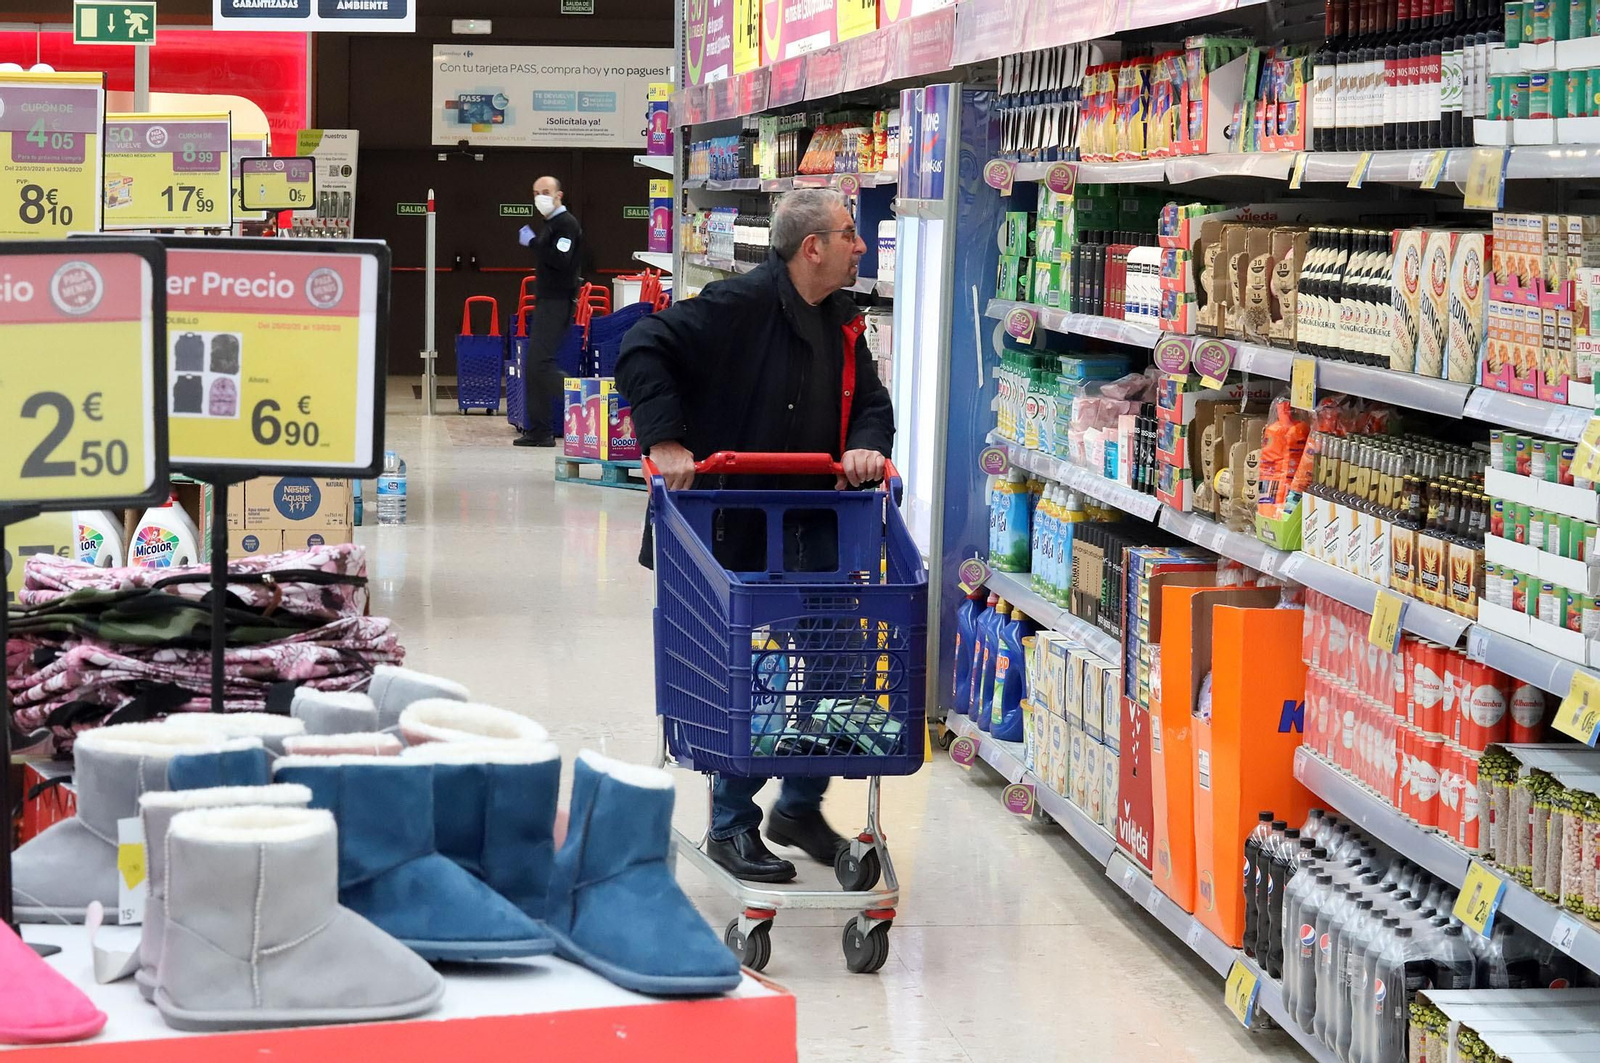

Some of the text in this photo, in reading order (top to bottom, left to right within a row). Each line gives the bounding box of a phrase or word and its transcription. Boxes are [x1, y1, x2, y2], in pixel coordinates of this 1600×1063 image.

[336, 1, 388, 10] AMBIENTE
[440, 63, 461, 72] Con
[463, 64, 473, 72] tu
[475, 64, 509, 75] tarjeta
[510, 64, 539, 74] PASS,
[541, 66, 581, 78] compra
[582, 65, 602, 76] hoy
[603, 67, 610, 76] y
[611, 67, 625, 75] no
[626, 68, 664, 78] pagues
[21, 101, 73, 113] CUPÓN DE
[582, 97, 589, 107] 3
[546, 117, 587, 126] ¡Solicítala
[26, 117, 48, 148] 4
[51, 133, 74, 149] 05
[182, 142, 214, 163] 8 99
[161, 185, 214, 213] 17 € 99
[289, 188, 298, 202] 0
[19, 184, 73, 226] 8 € 10
[400, 205, 427, 213] SALIDA
[503, 206, 530, 214] SALIDA
[1236, 208, 1278, 220] vileda
[62, 271, 88, 286] PAGA
[202, 271, 295, 298] Precio
[314, 276, 331, 286] PAGA
[62, 280, 94, 298] MENOS
[313, 284, 337, 296] MENOS
[251, 396, 320, 447] 6 € 90
[20, 391, 128, 478] 2 € 50
[612, 438, 637, 447] DODOT
[282, 493, 312, 503] Aquarel
[1473, 699, 1503, 708] Alhambra
[1514, 698, 1543, 708] Alhambra
[1119, 806, 1148, 860] vileda
[1561, 927, 1570, 947] 2
